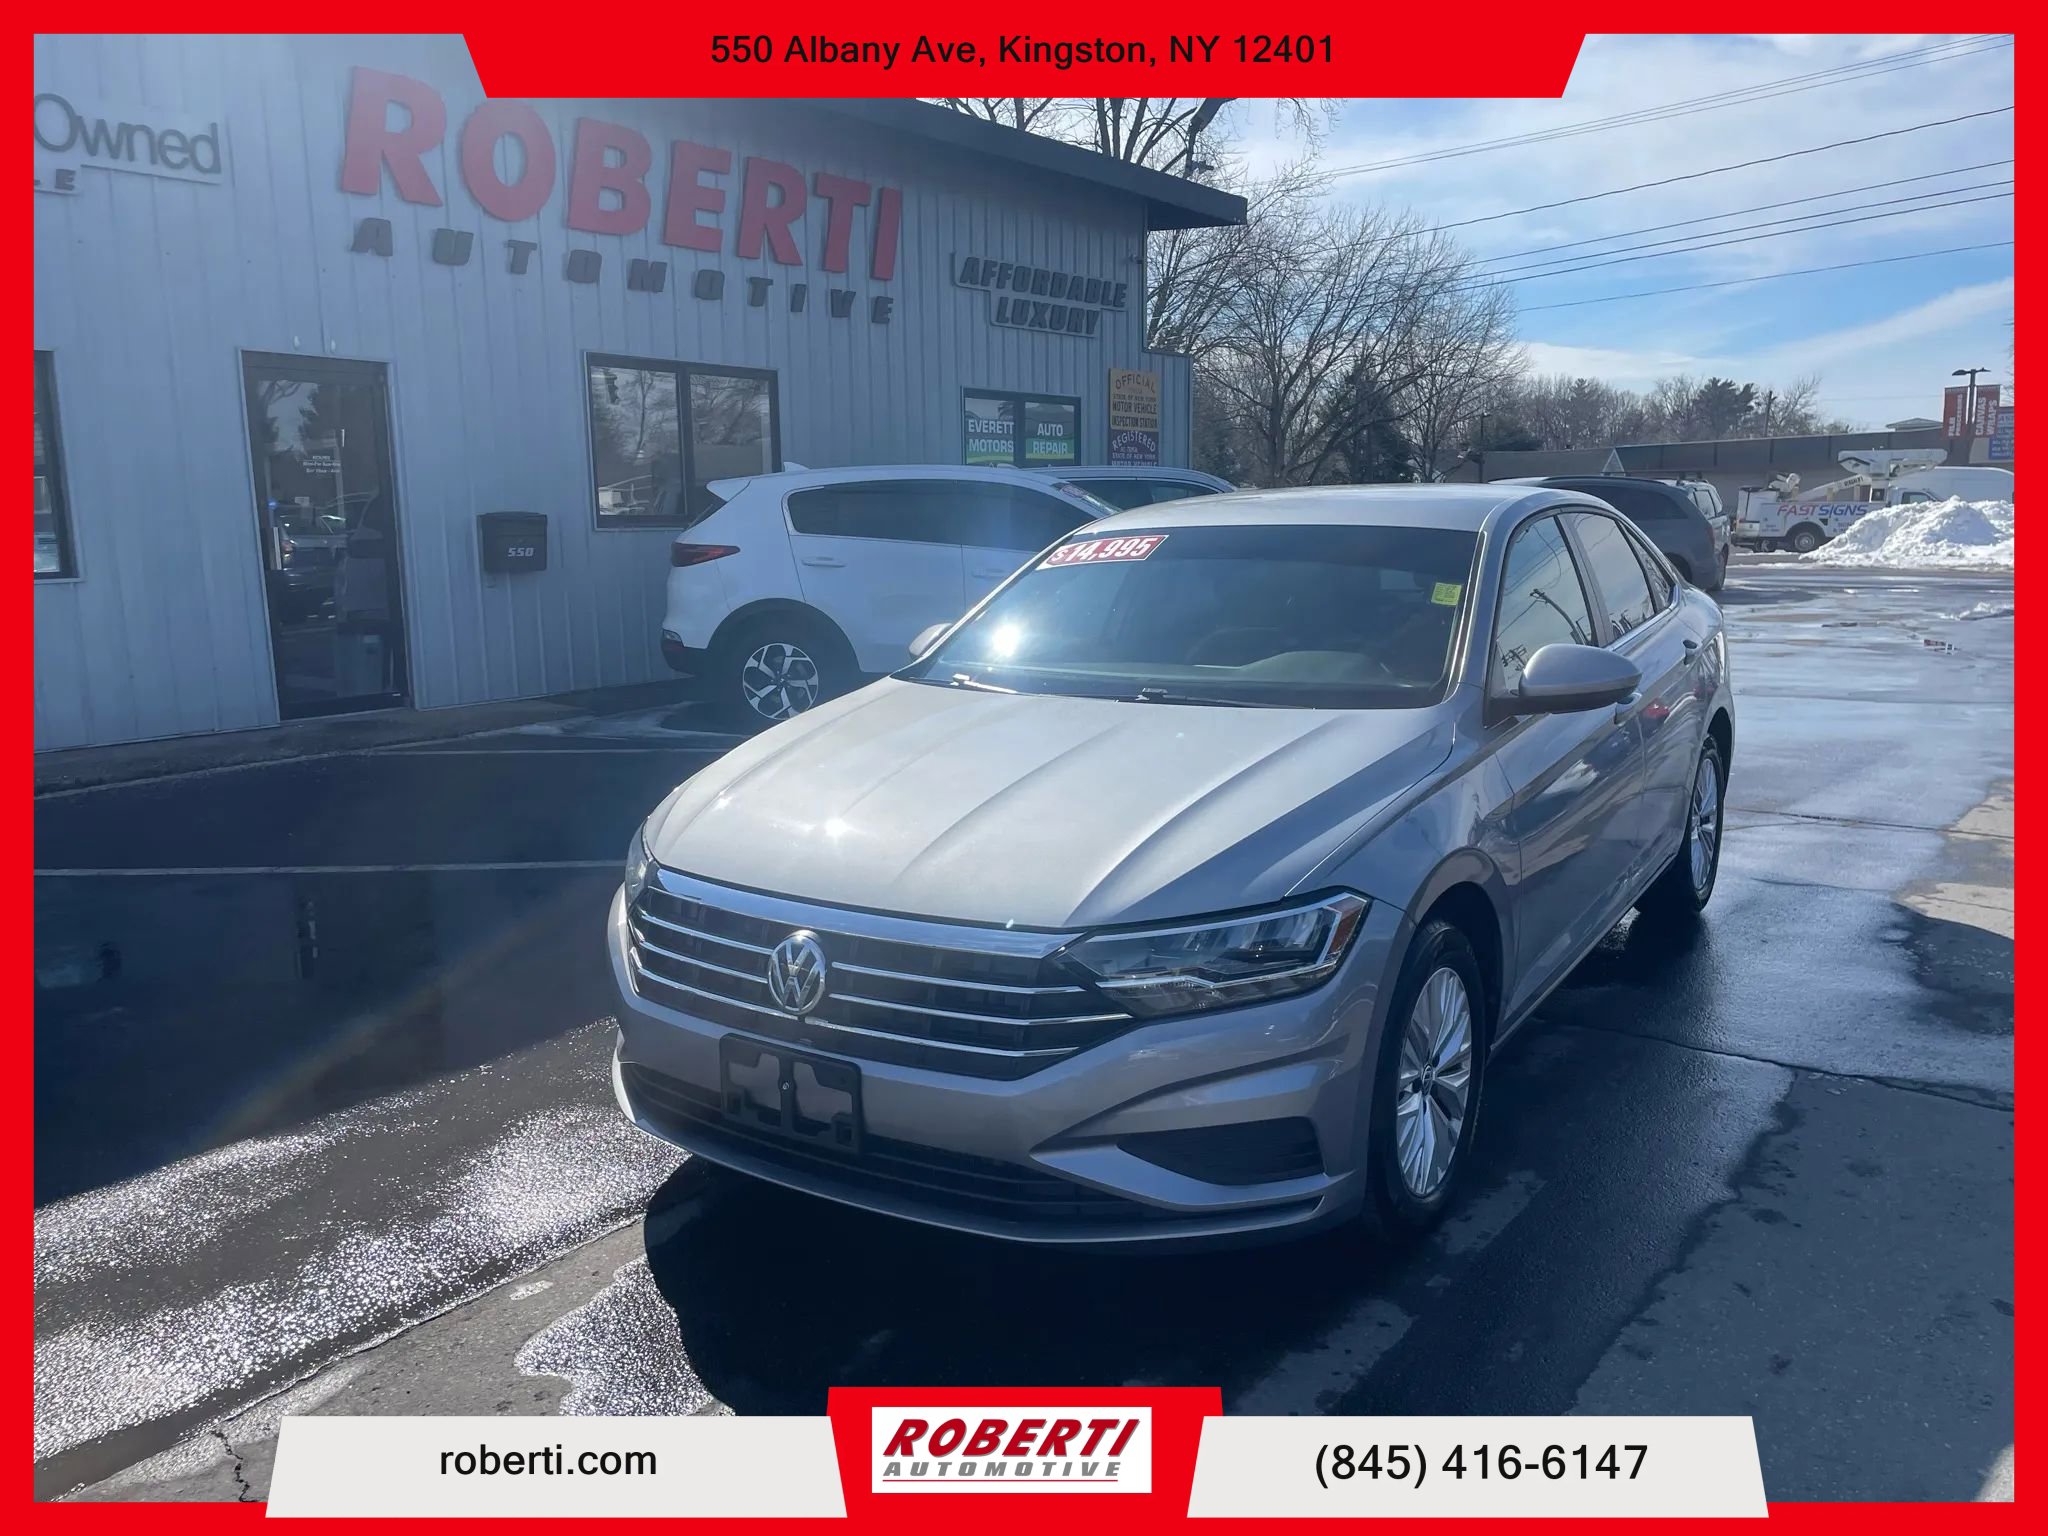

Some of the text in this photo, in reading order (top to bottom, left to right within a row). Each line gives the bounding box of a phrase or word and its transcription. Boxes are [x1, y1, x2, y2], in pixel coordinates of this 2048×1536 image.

[34, 93, 221, 174] Owned
[340, 65, 903, 281] ROBERTI
[350, 217, 894, 324] AUTOMOTIVE
[959, 256, 1128, 307] AFFORDABLE
[995, 296, 1100, 334] LUXURY
[1115, 374, 1156, 394] OFFICIAL
[1112, 401, 1157, 414] MOTOR VEHICLE
[1975, 396, 1987, 435] CANVAS
[968, 419, 1014, 434] EVERETT
[1037, 423, 1064, 436] AUTO
[1112, 415, 1157, 429] INSPECTION STATION
[968, 439, 1014, 453] MOTORS
[1032, 441, 1068, 454] REPAIR
[1112, 431, 1156, 452] REGISTERED
[1776, 504, 1869, 518] FASTSIGNS
[507, 547, 534, 557] 550
[1051, 537, 1158, 563] $14,995
